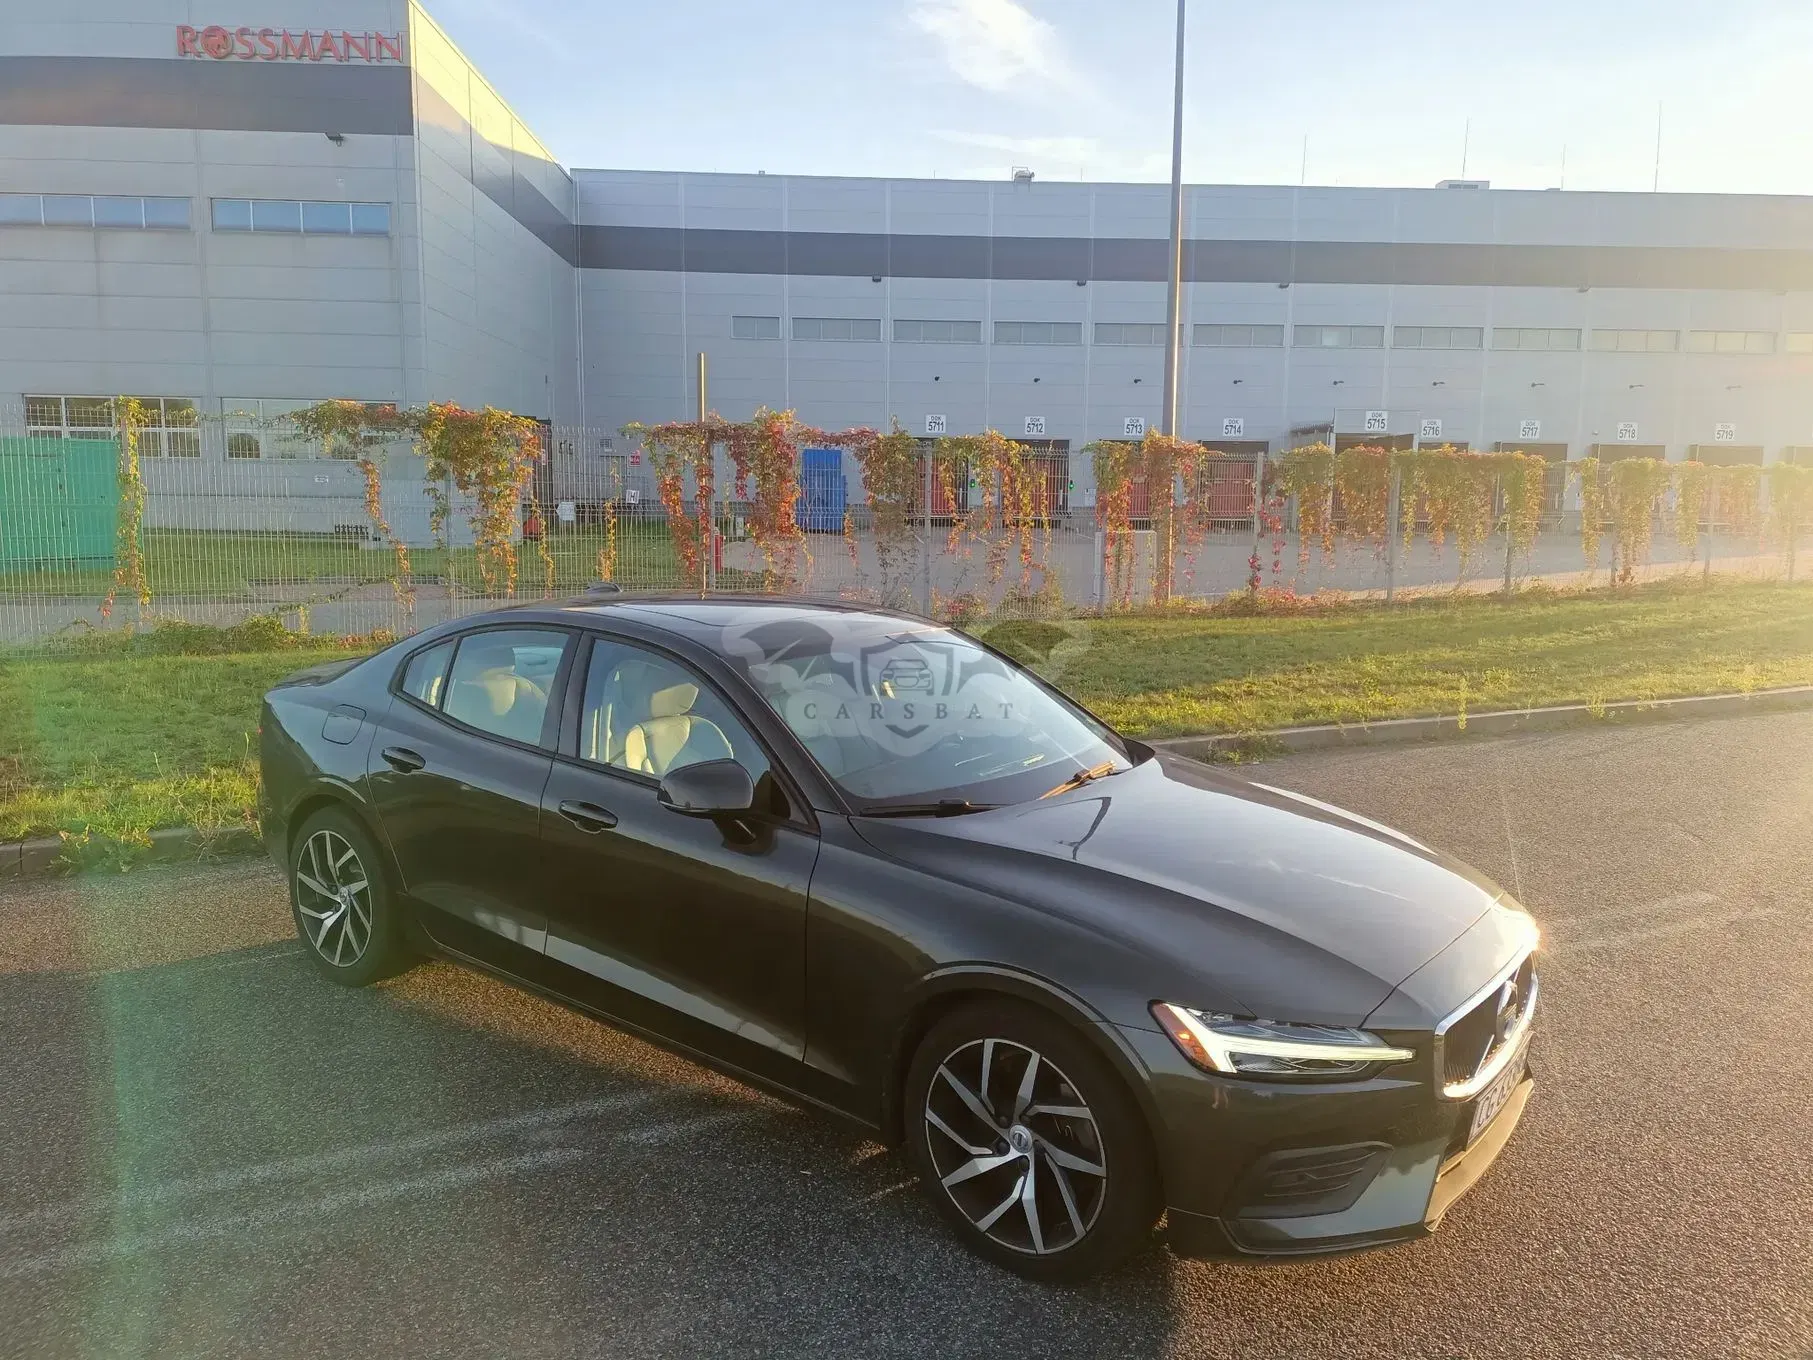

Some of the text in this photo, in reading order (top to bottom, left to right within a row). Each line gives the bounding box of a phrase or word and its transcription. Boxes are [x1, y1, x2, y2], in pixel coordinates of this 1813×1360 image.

[176, 24, 403, 64] ROSSMANN
[928, 421, 944, 431] 5711
[1026, 423, 1043, 433] 5712
[1126, 424, 1143, 434] 5713
[1367, 419, 1385, 429] 5715
[1224, 425, 1241, 435] 5714
[1423, 426, 1440, 436] 5716
[1522, 427, 1538, 436] 5717
[1619, 429, 1636, 438] 5718
[1716, 430, 1733, 439] 5719
